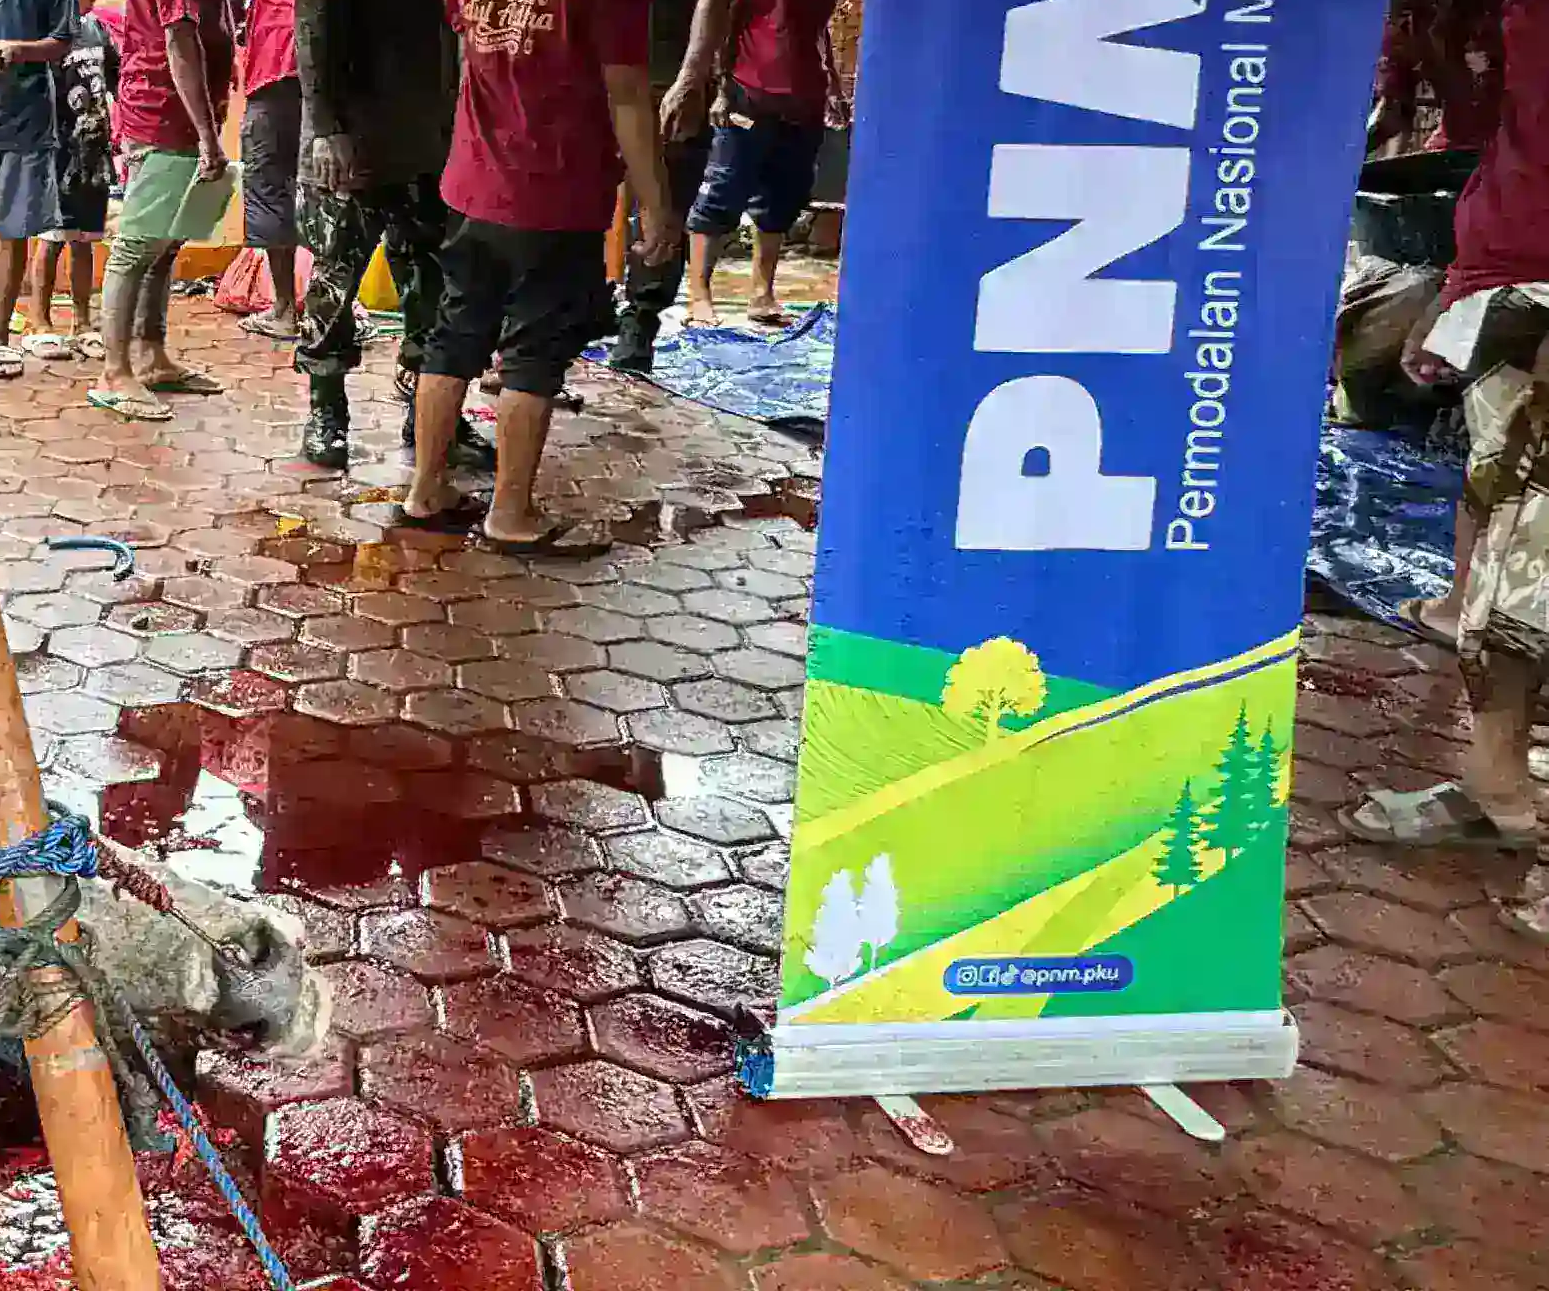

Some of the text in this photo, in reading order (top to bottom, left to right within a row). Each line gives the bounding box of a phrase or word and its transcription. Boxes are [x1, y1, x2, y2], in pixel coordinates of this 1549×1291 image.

[1198, 44, 1269, 251] Nasional
[1165, 271, 1242, 550] Permodalan
[1021, 965, 1120, 986] @pnm.pku
